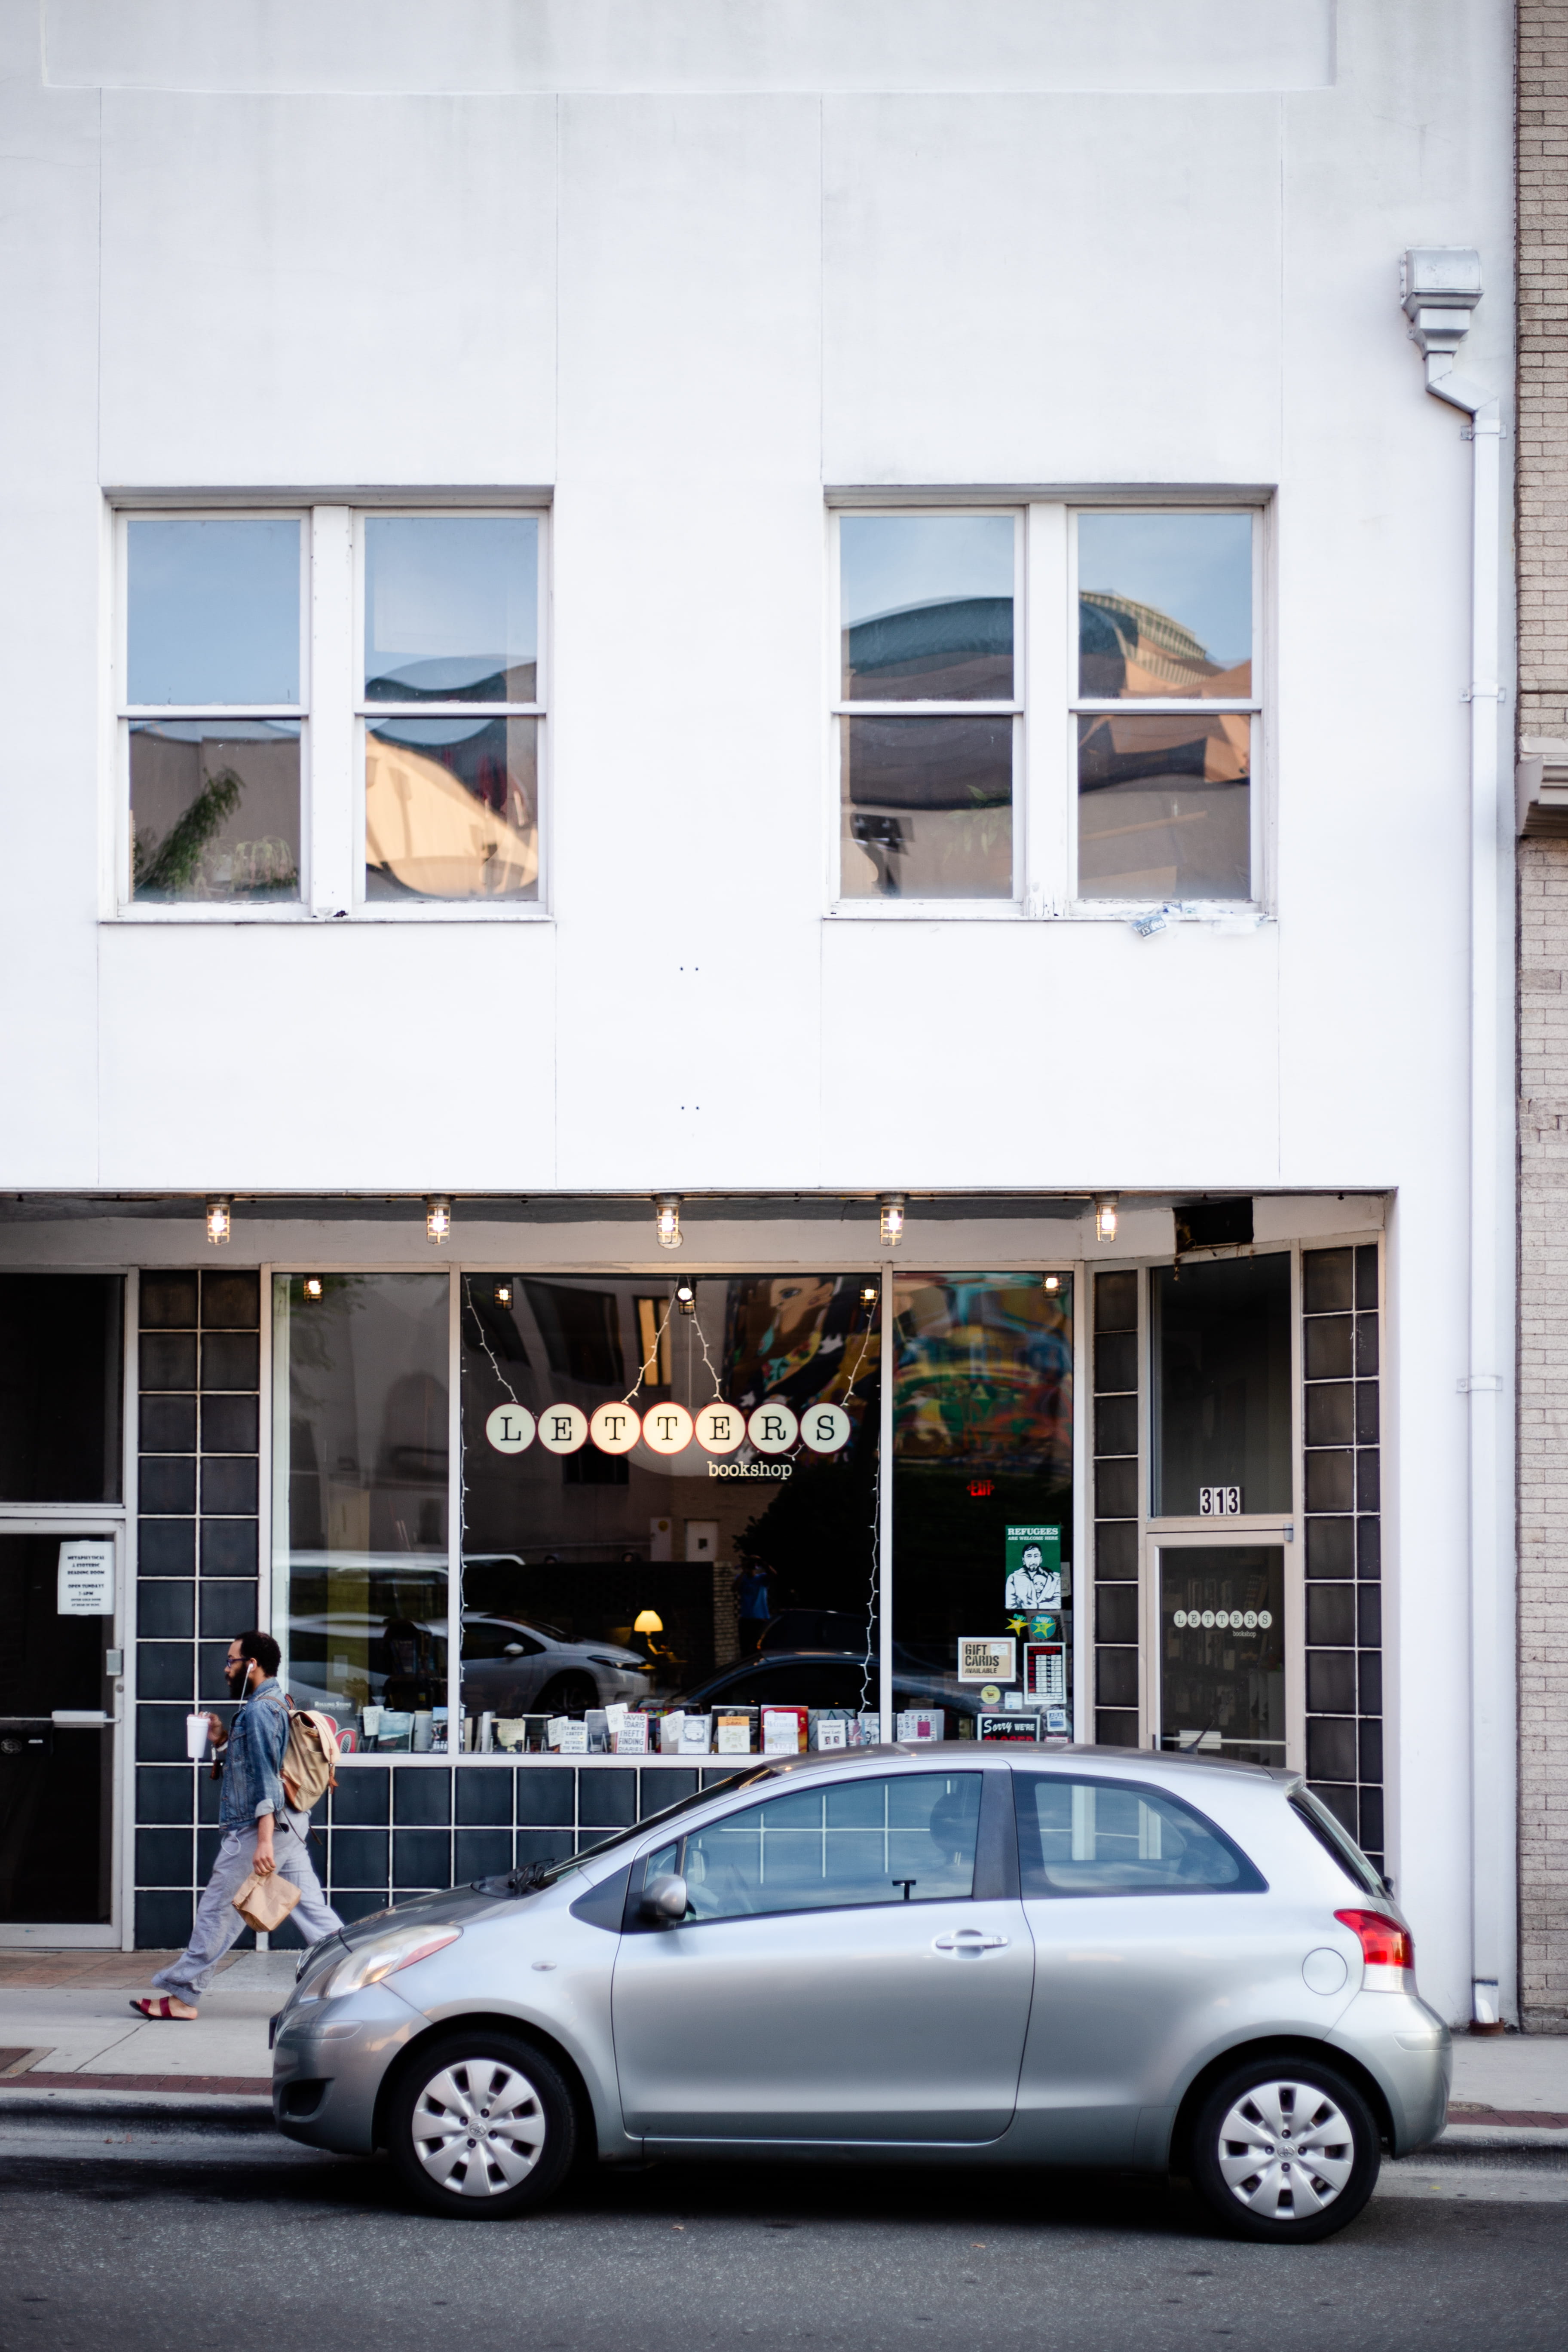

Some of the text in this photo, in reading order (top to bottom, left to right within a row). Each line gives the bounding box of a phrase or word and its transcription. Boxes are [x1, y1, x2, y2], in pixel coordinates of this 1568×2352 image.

[500, 1415, 835, 1441] LETTERS
[707, 1461, 792, 1479] bookshop
[971, 1480, 991, 1496] EXIT
[1202, 1488, 1238, 1514] 313
[1177, 1614, 1268, 1624] LETTERS
[965, 1644, 987, 1655] GIFT
[965, 1655, 999, 1666] CARDS
[983, 1719, 1012, 1733] Sorry
